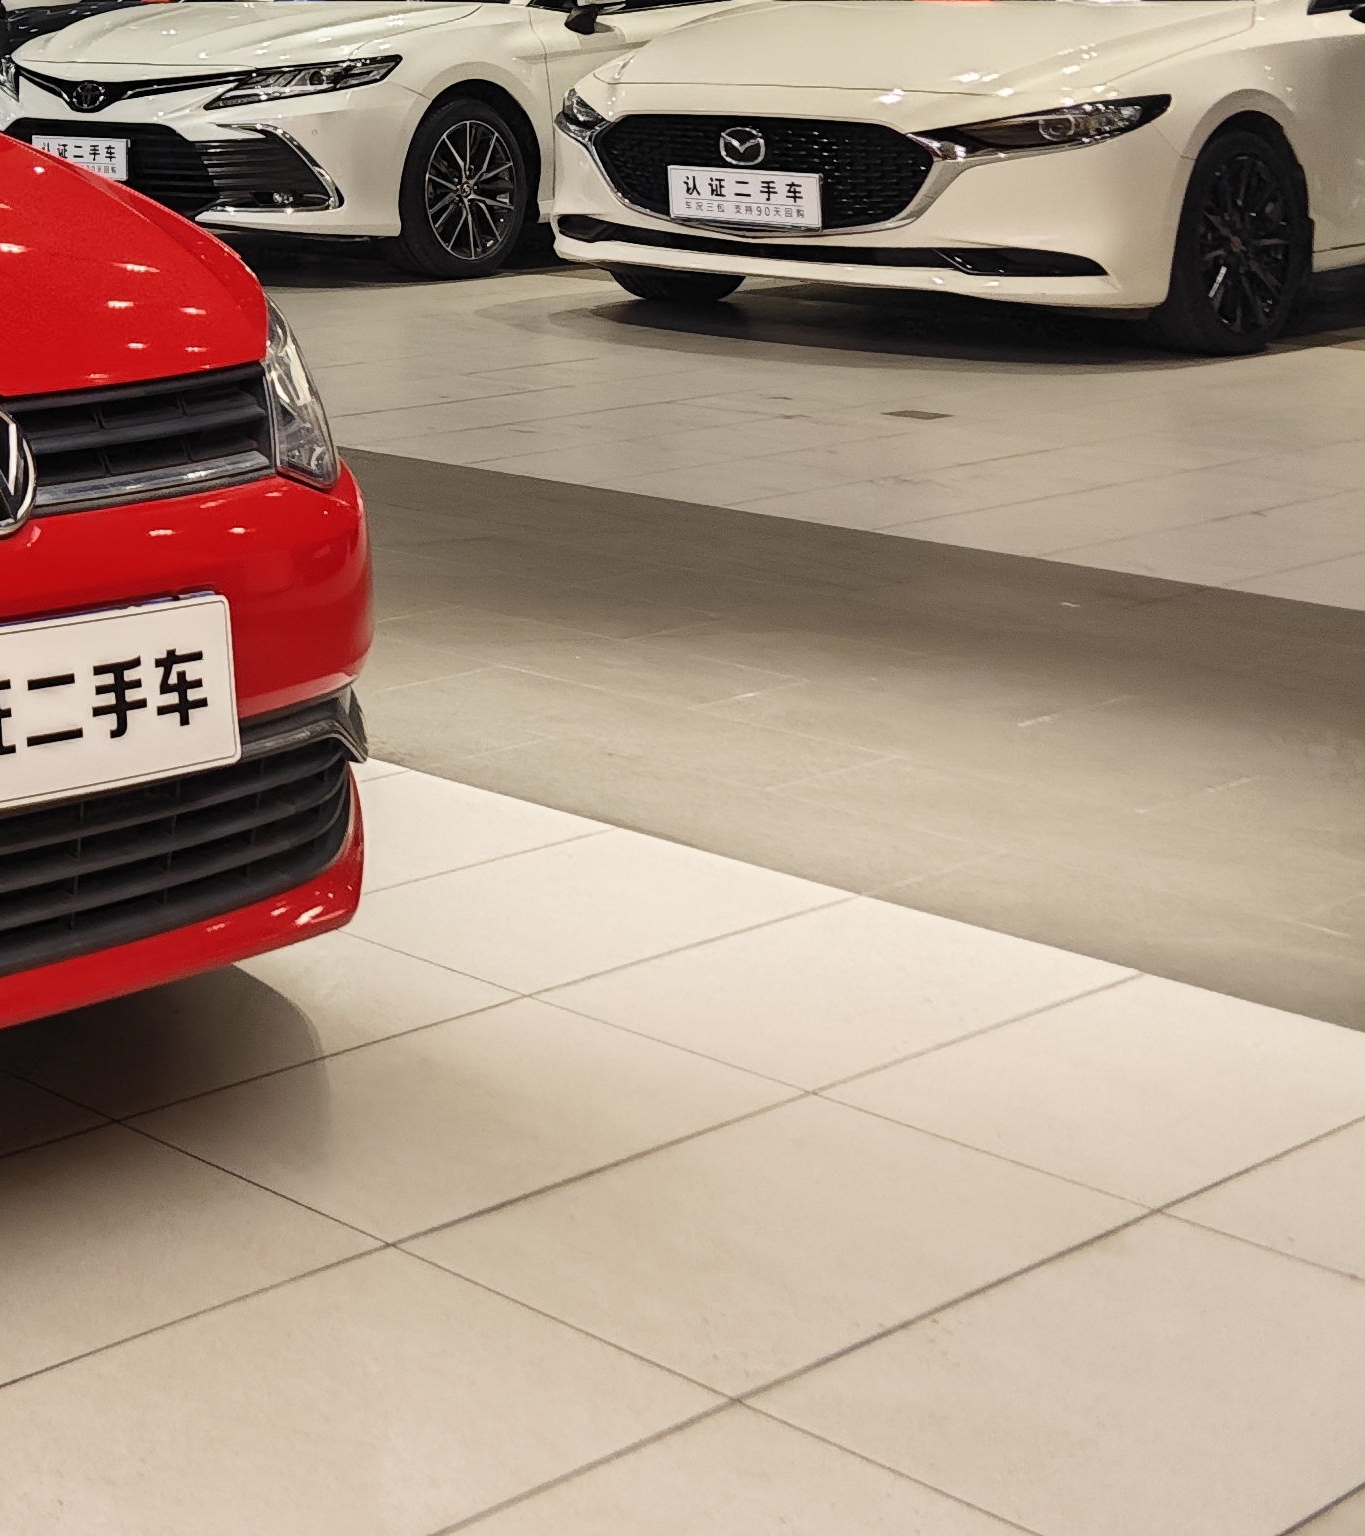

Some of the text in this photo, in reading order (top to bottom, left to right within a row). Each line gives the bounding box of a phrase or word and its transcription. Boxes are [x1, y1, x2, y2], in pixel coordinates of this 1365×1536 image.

[683, 175, 804, 204] 认证二手车
